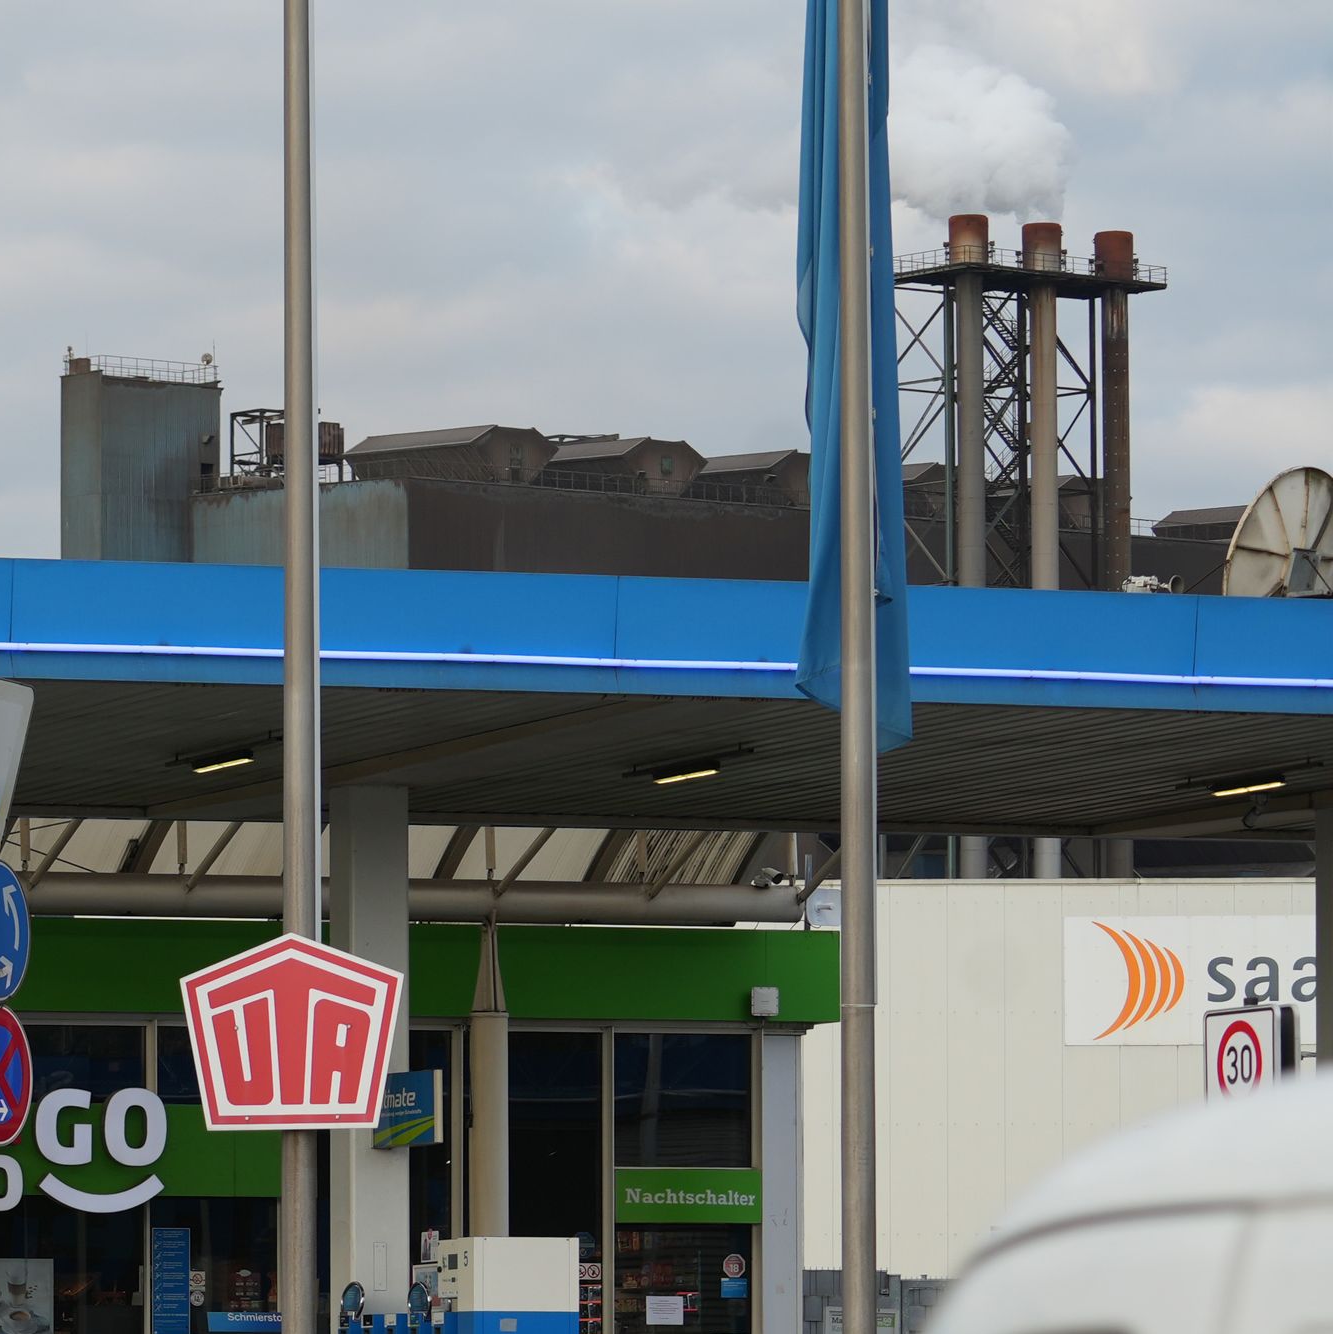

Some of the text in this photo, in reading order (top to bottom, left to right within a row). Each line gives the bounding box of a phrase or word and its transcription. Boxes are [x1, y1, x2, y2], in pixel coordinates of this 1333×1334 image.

[207, 957, 377, 1106] UTA
[1226, 1044, 1252, 1085] 30
[384, 1087, 416, 1108] timate
[35, 1087, 167, 1167] GO
[625, 1188, 756, 1206] Nachtschalter
[463, 1250, 469, 1267] 5
[227, 1312, 282, 1322] Schmiersto
